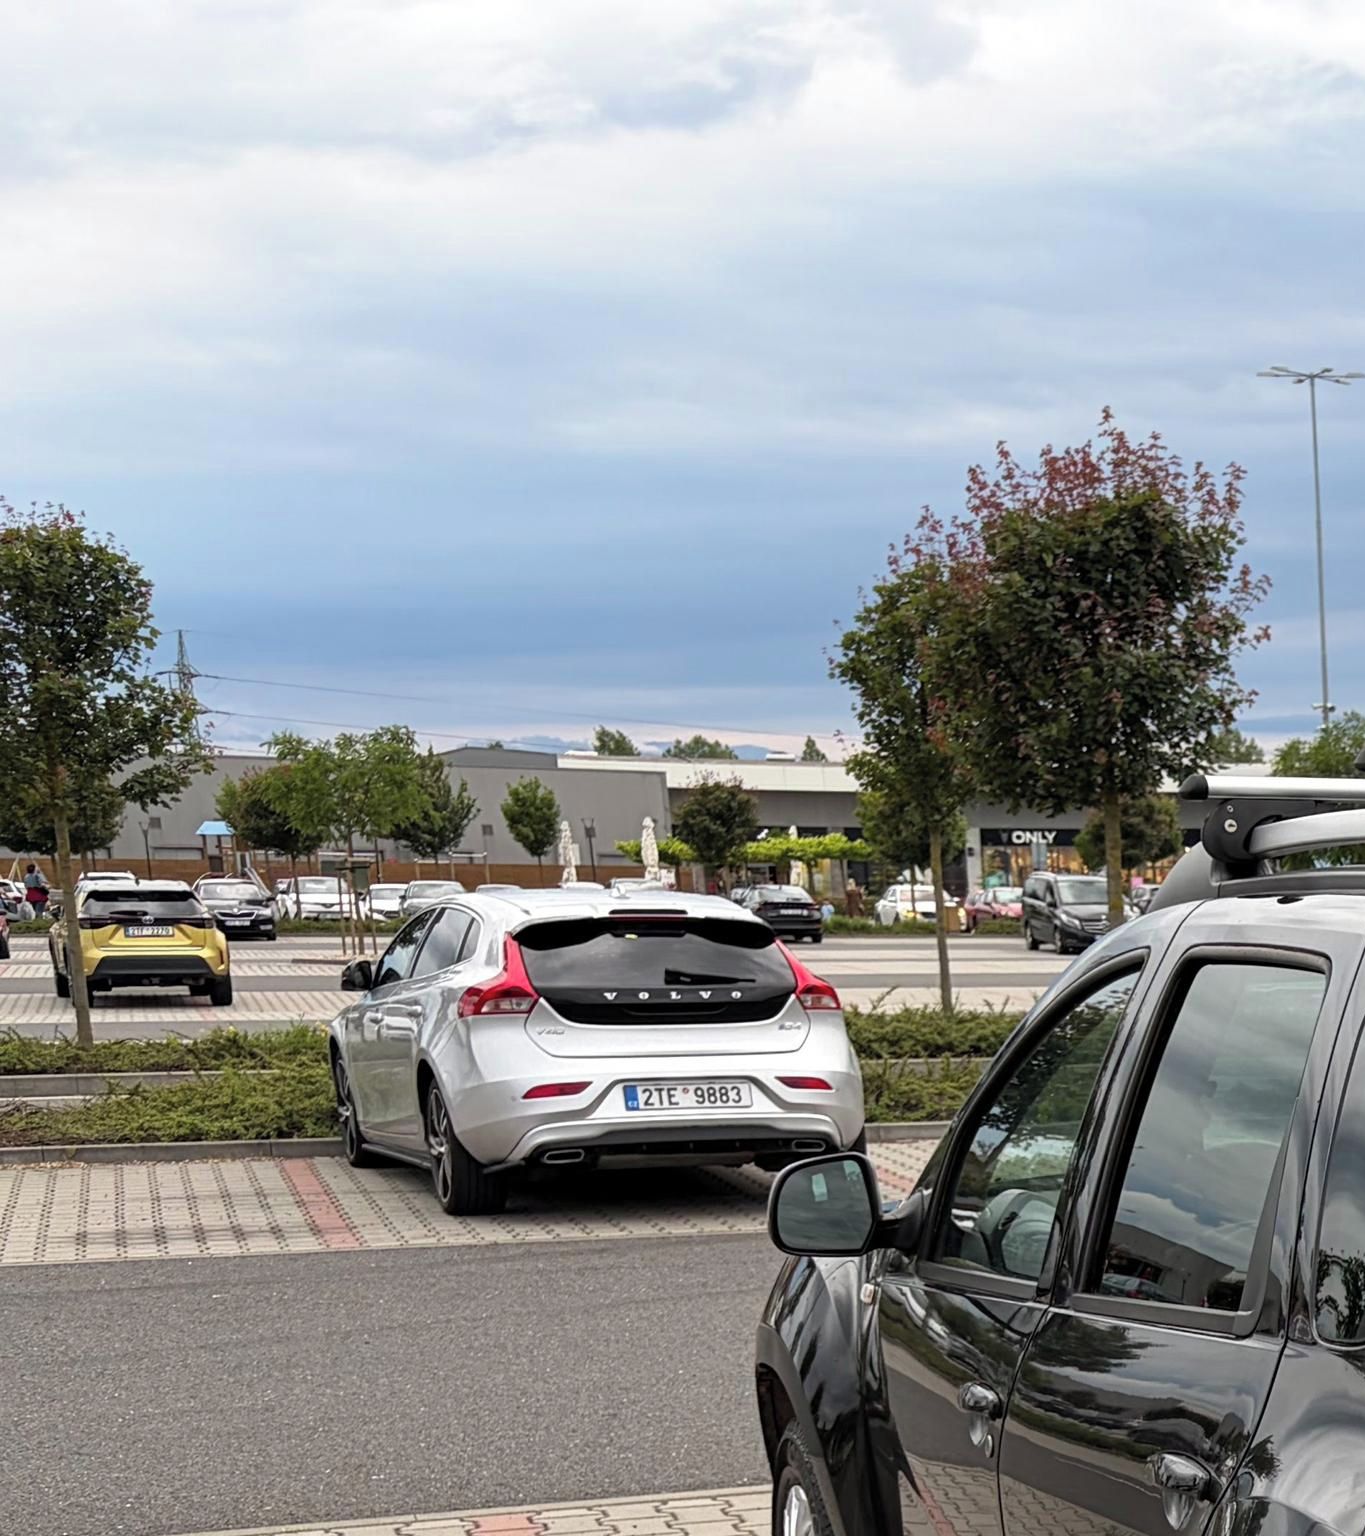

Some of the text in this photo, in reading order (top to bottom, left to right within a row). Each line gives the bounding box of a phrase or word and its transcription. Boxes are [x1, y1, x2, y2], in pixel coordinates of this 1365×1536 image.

[1011, 830, 1057, 845] ONLY
[603, 990, 743, 1001] VOLVO
[641, 1086, 680, 1107] 2TE
[694, 1086, 743, 1106] 9883
